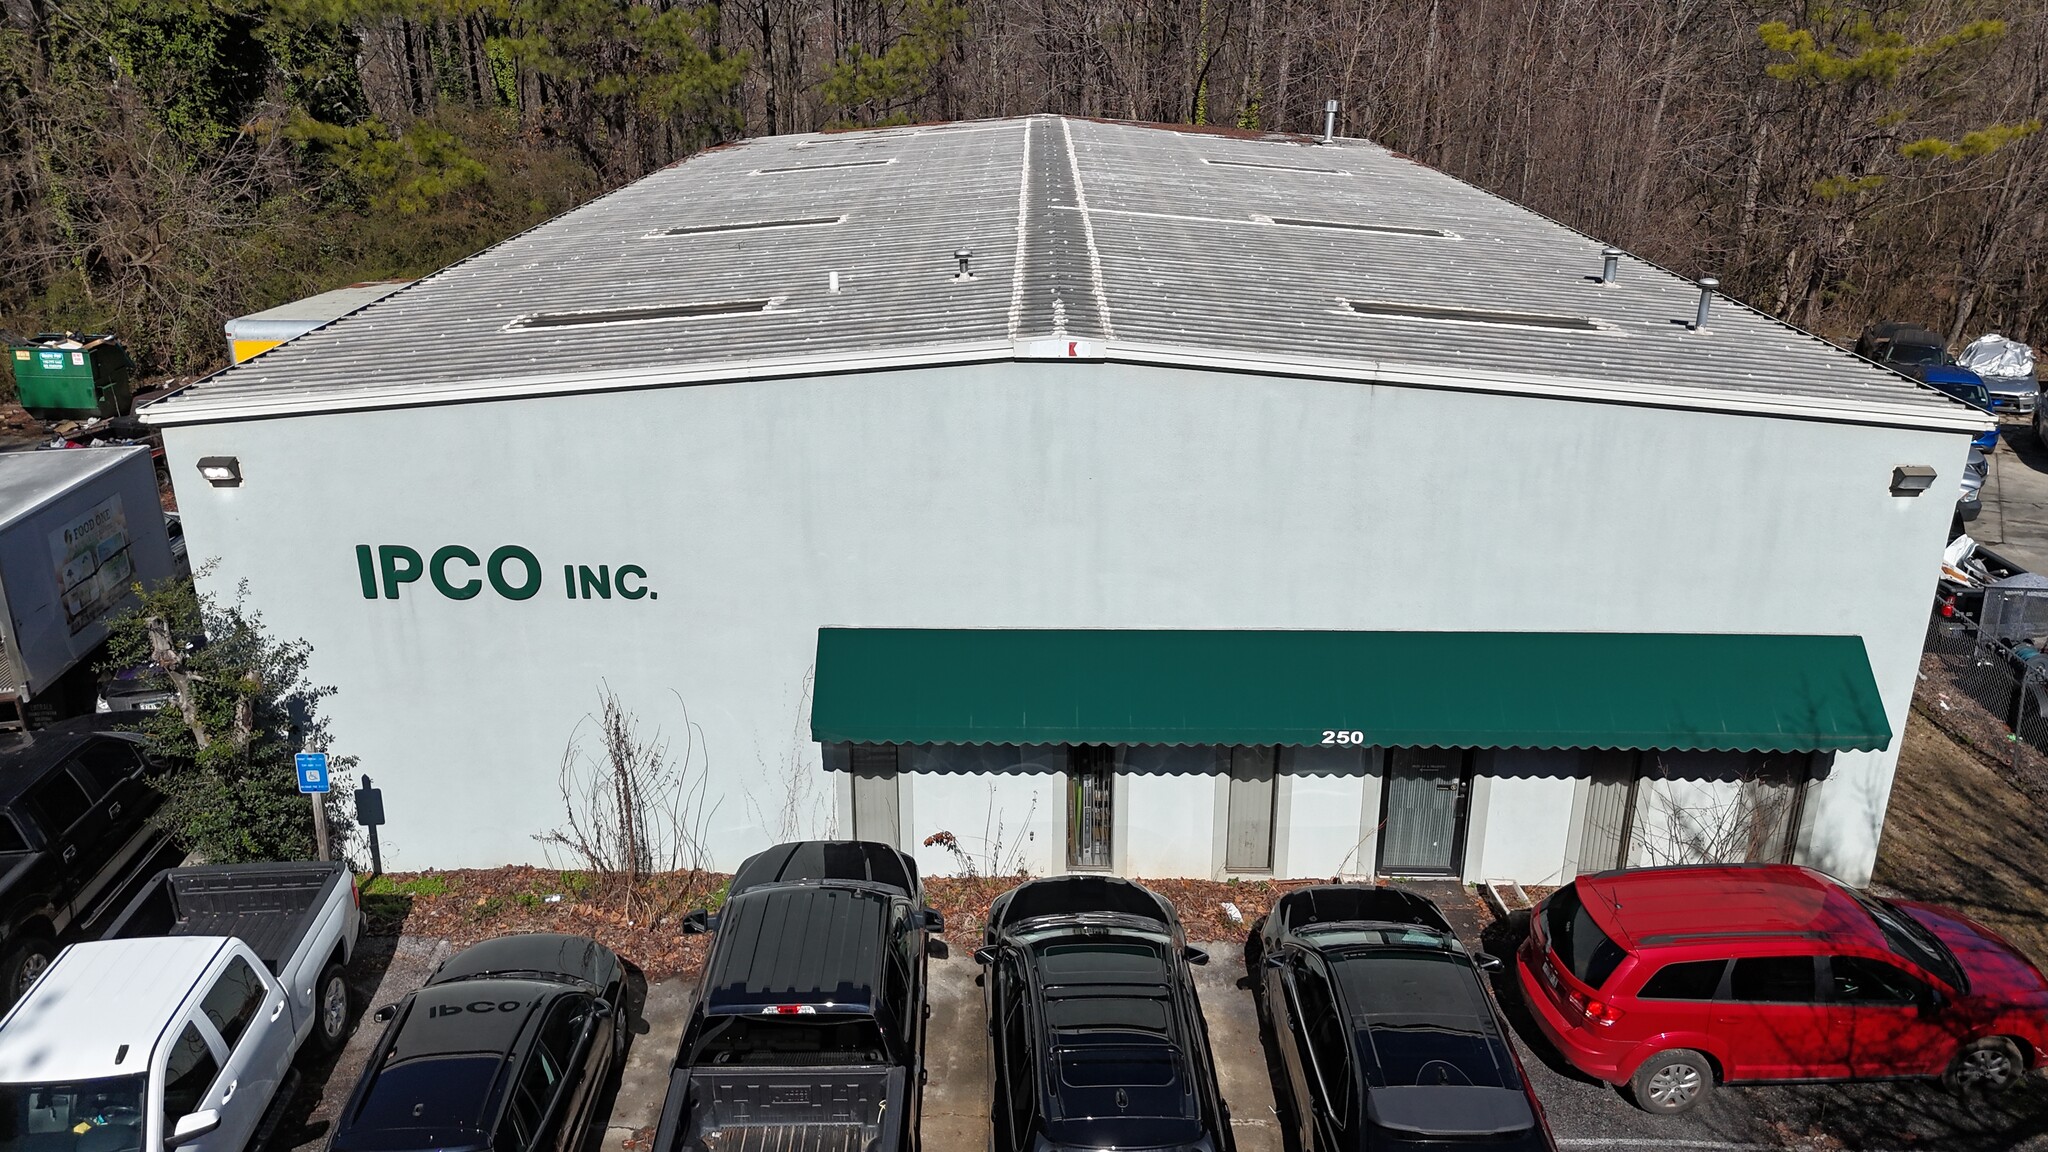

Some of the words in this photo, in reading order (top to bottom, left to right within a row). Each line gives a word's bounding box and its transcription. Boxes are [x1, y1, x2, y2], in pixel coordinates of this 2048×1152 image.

[73, 518, 95, 540] FOOD
[95, 508, 111, 526] ONE
[355, 544, 542, 601] IPCO
[564, 564, 658, 600] INC.
[1321, 730, 1364, 745] 250
